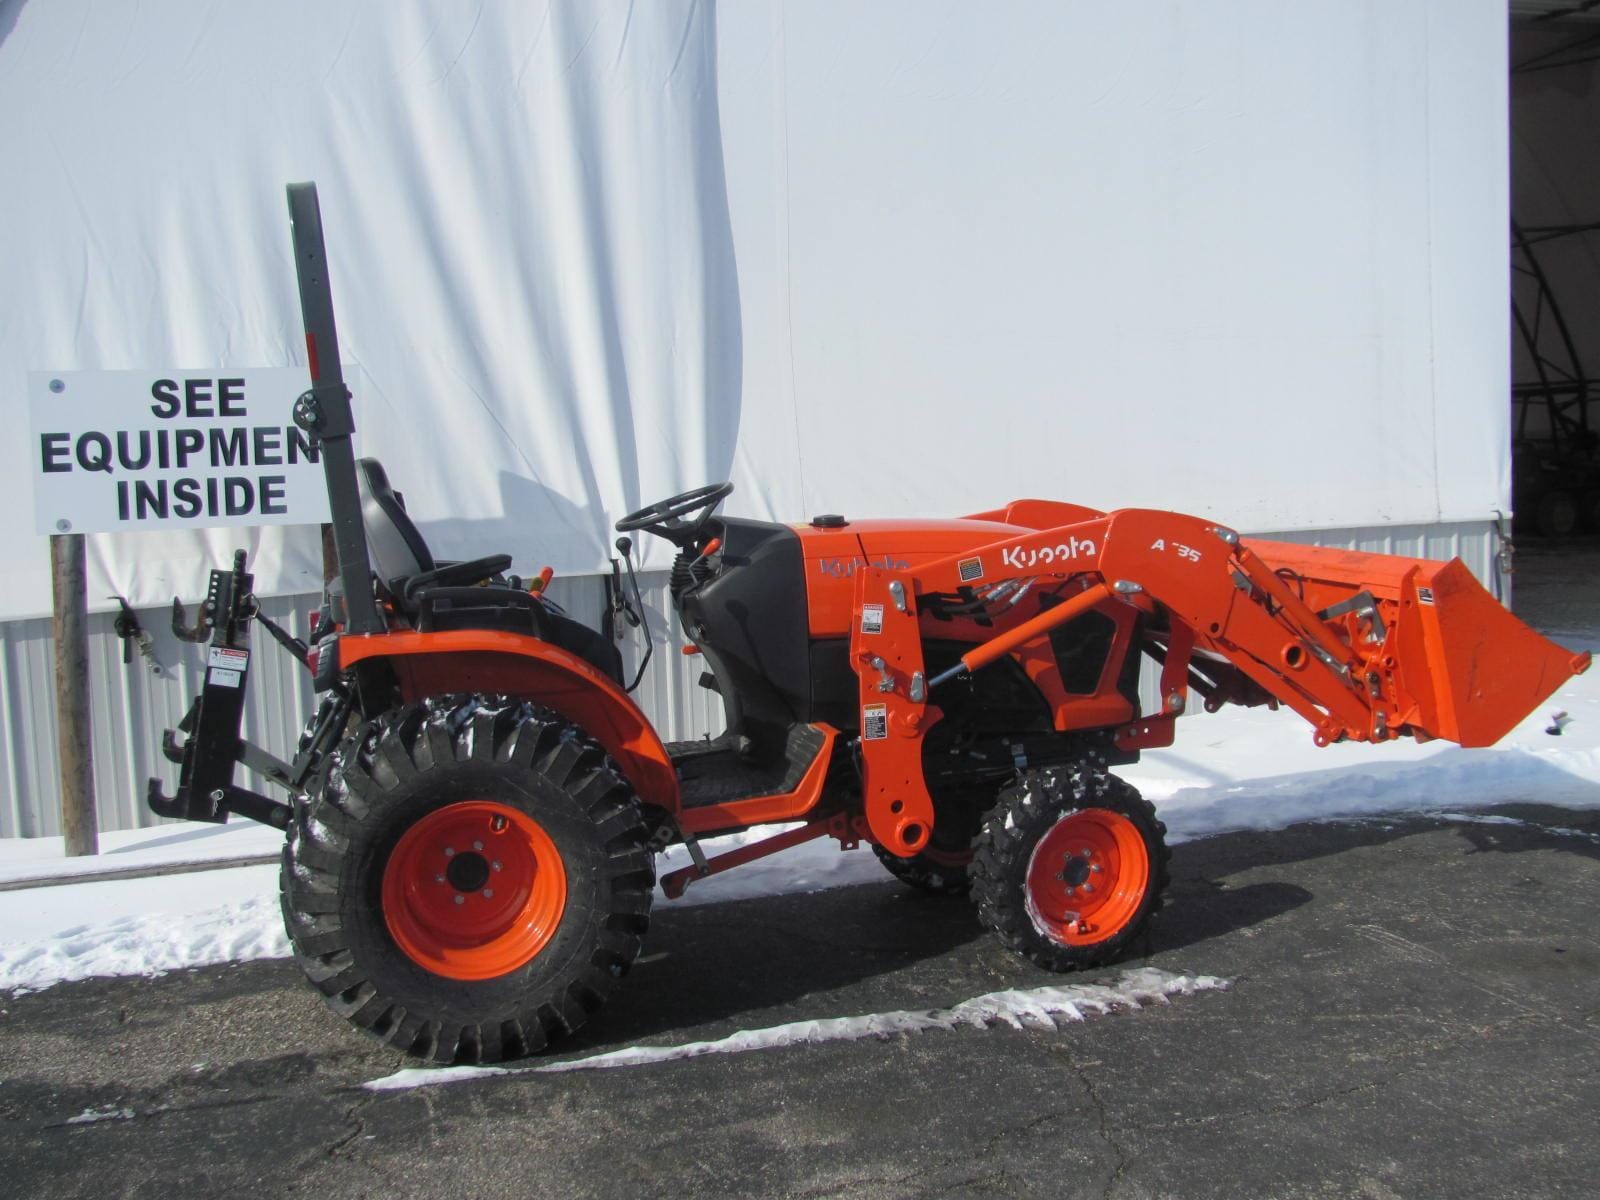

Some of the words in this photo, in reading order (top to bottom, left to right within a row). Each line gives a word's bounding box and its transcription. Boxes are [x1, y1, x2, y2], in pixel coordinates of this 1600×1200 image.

[151, 378, 247, 418] SEE
[41, 426, 320, 474] EQUIPMEN
[117, 475, 287, 520] INSIDE
